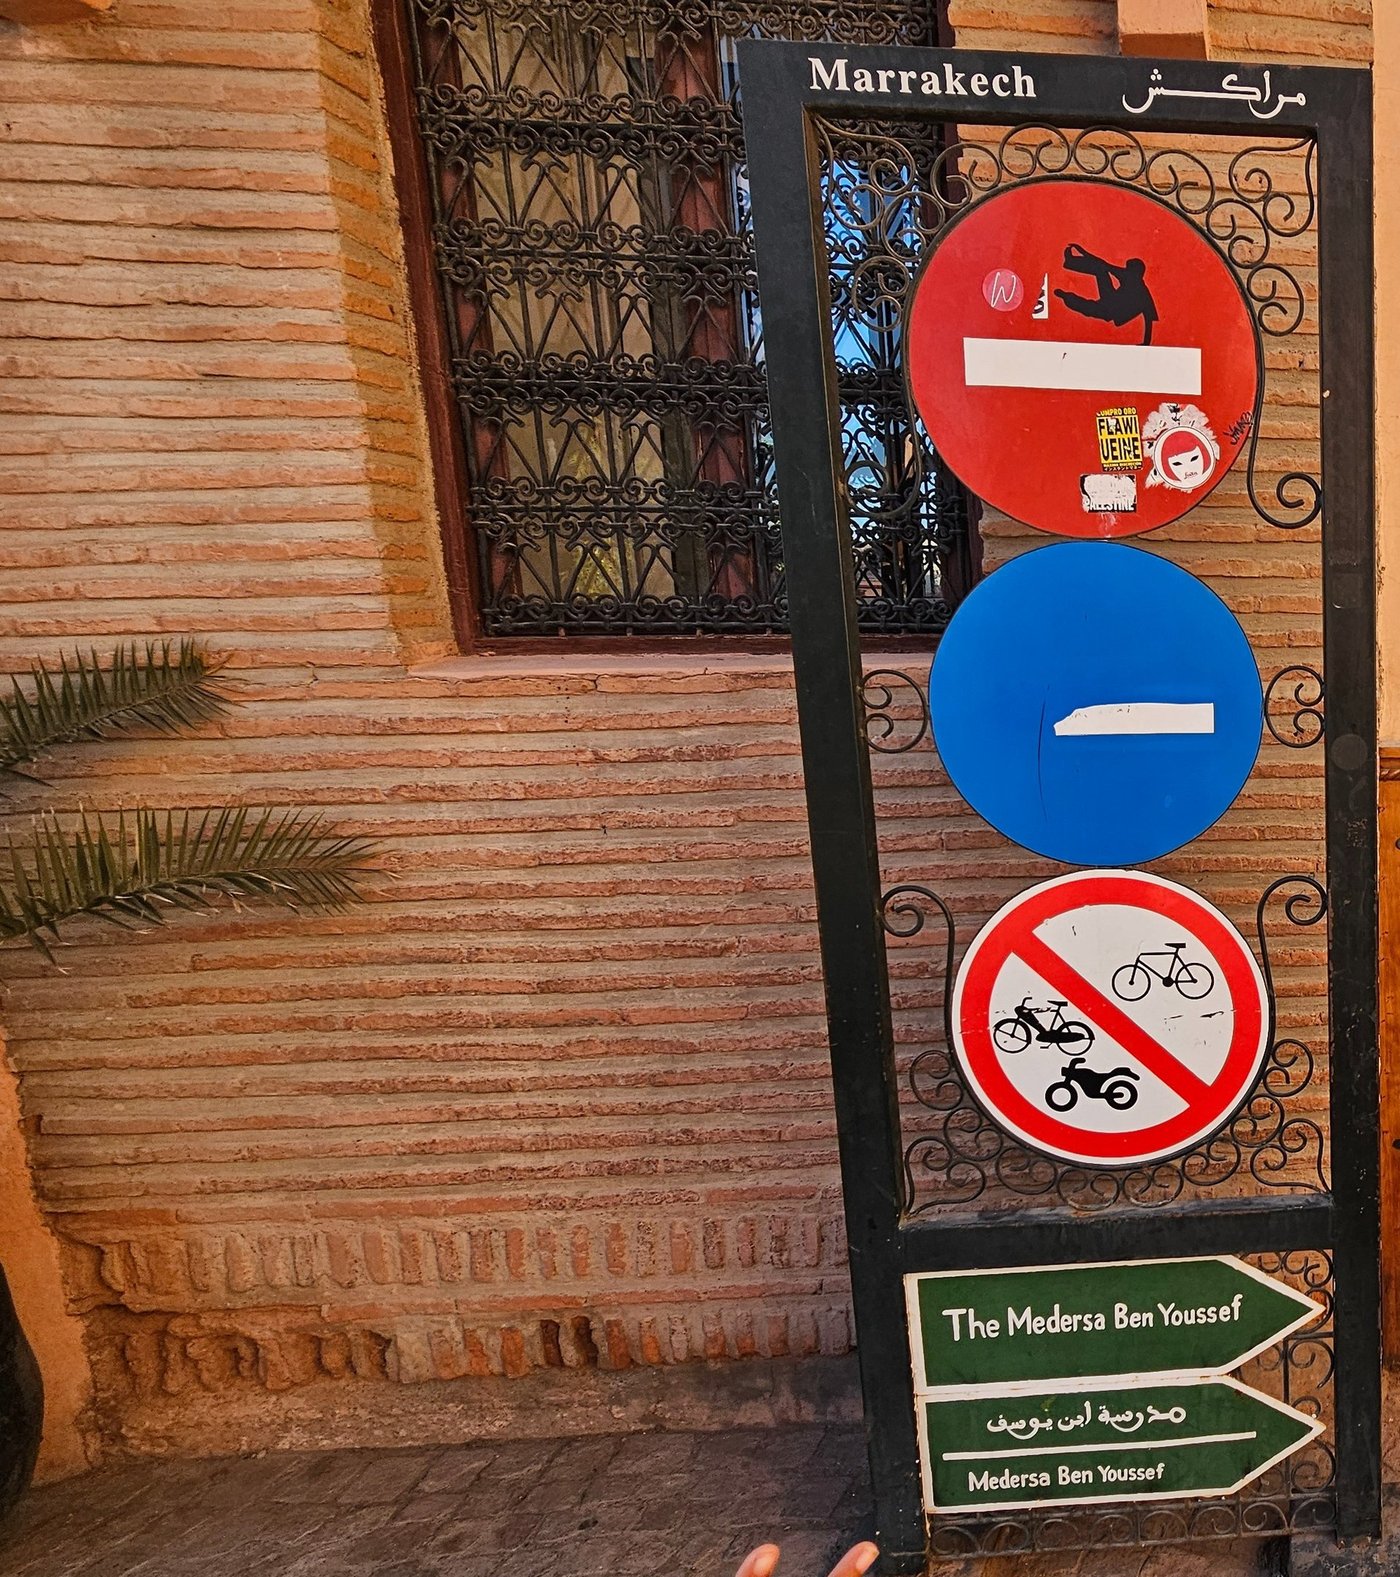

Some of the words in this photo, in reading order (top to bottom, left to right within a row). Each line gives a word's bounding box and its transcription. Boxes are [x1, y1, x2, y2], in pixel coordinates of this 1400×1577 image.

[808, 57, 1036, 98] Marrakech
[1122, 68, 1306, 119] مراكش
[1123, 407, 1137, 415] ORO
[942, 1308, 1000, 1342] The
[1007, 1303, 1106, 1337] Medersa
[1114, 1303, 1154, 1331] Ben
[1157, 1293, 1244, 1326] Youssef
[986, 1413, 1053, 1440] يوسف
[1057, 1401, 1092, 1432] ابن
[1098, 1404, 1187, 1433] مدرسة
[968, 1467, 1051, 1492] Medersa
[1058, 1464, 1093, 1485] Ben
[1097, 1463, 1166, 1483] Youssef
